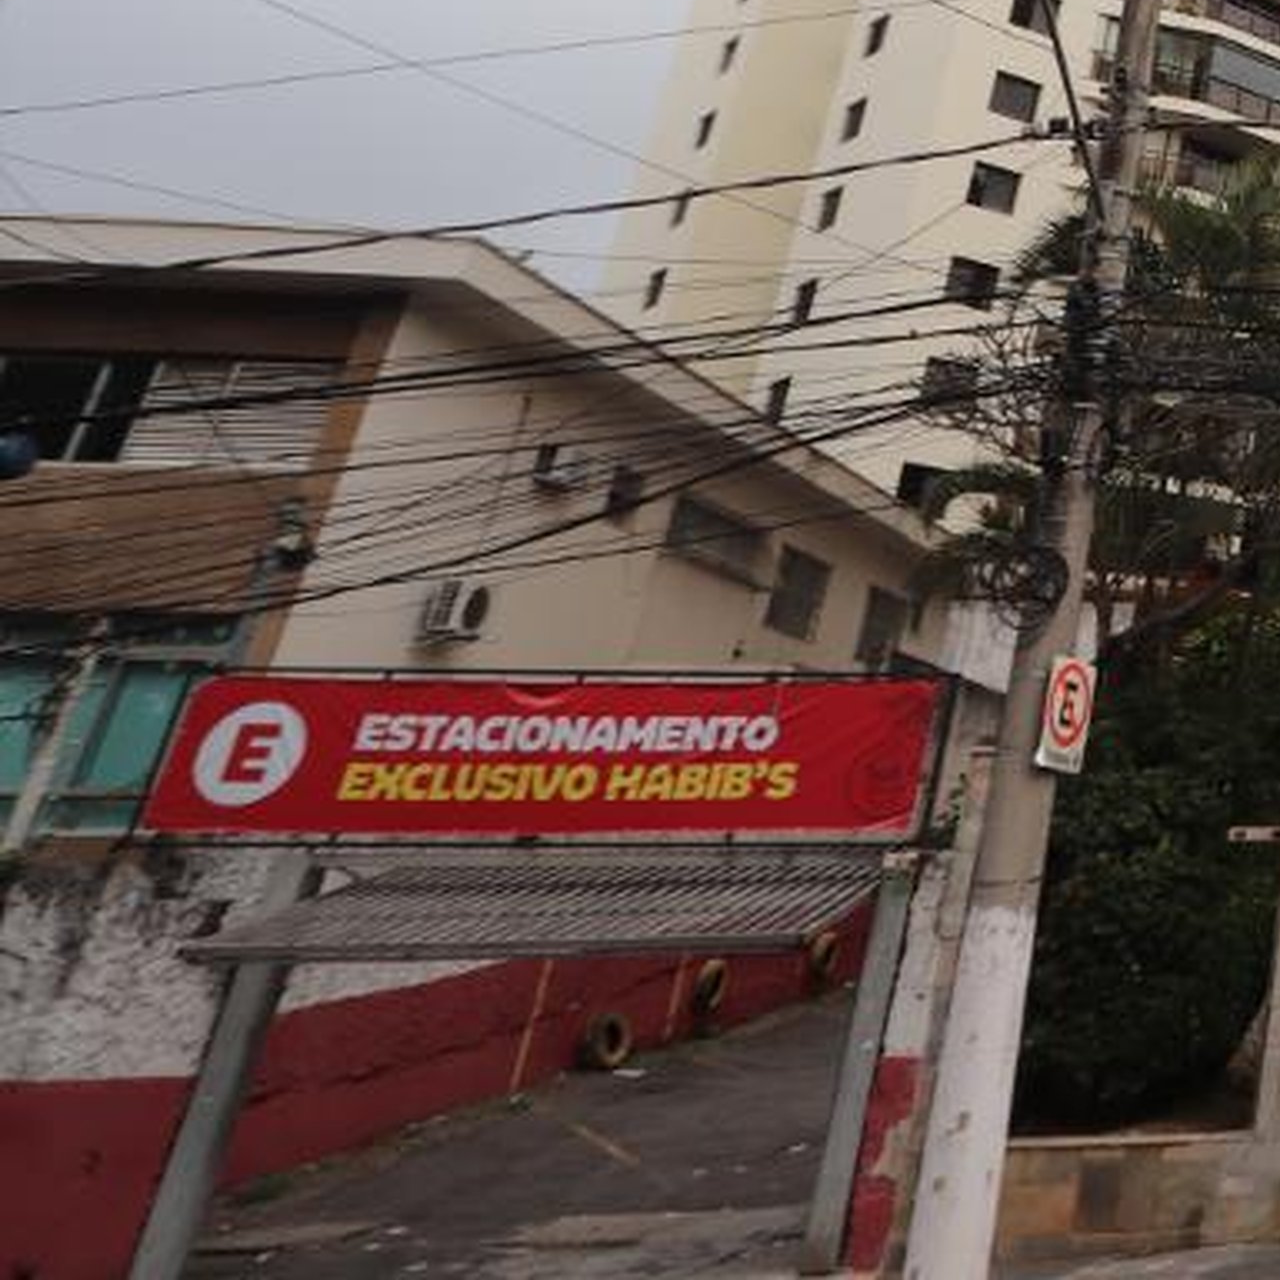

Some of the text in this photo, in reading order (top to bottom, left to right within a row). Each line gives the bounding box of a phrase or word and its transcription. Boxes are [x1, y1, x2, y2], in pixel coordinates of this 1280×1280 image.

[218, 723, 283, 783] E
[353, 714, 780, 753] ESTACIONAMENTO
[337, 761, 799, 801] EXCLUSIVO HABIB'S
